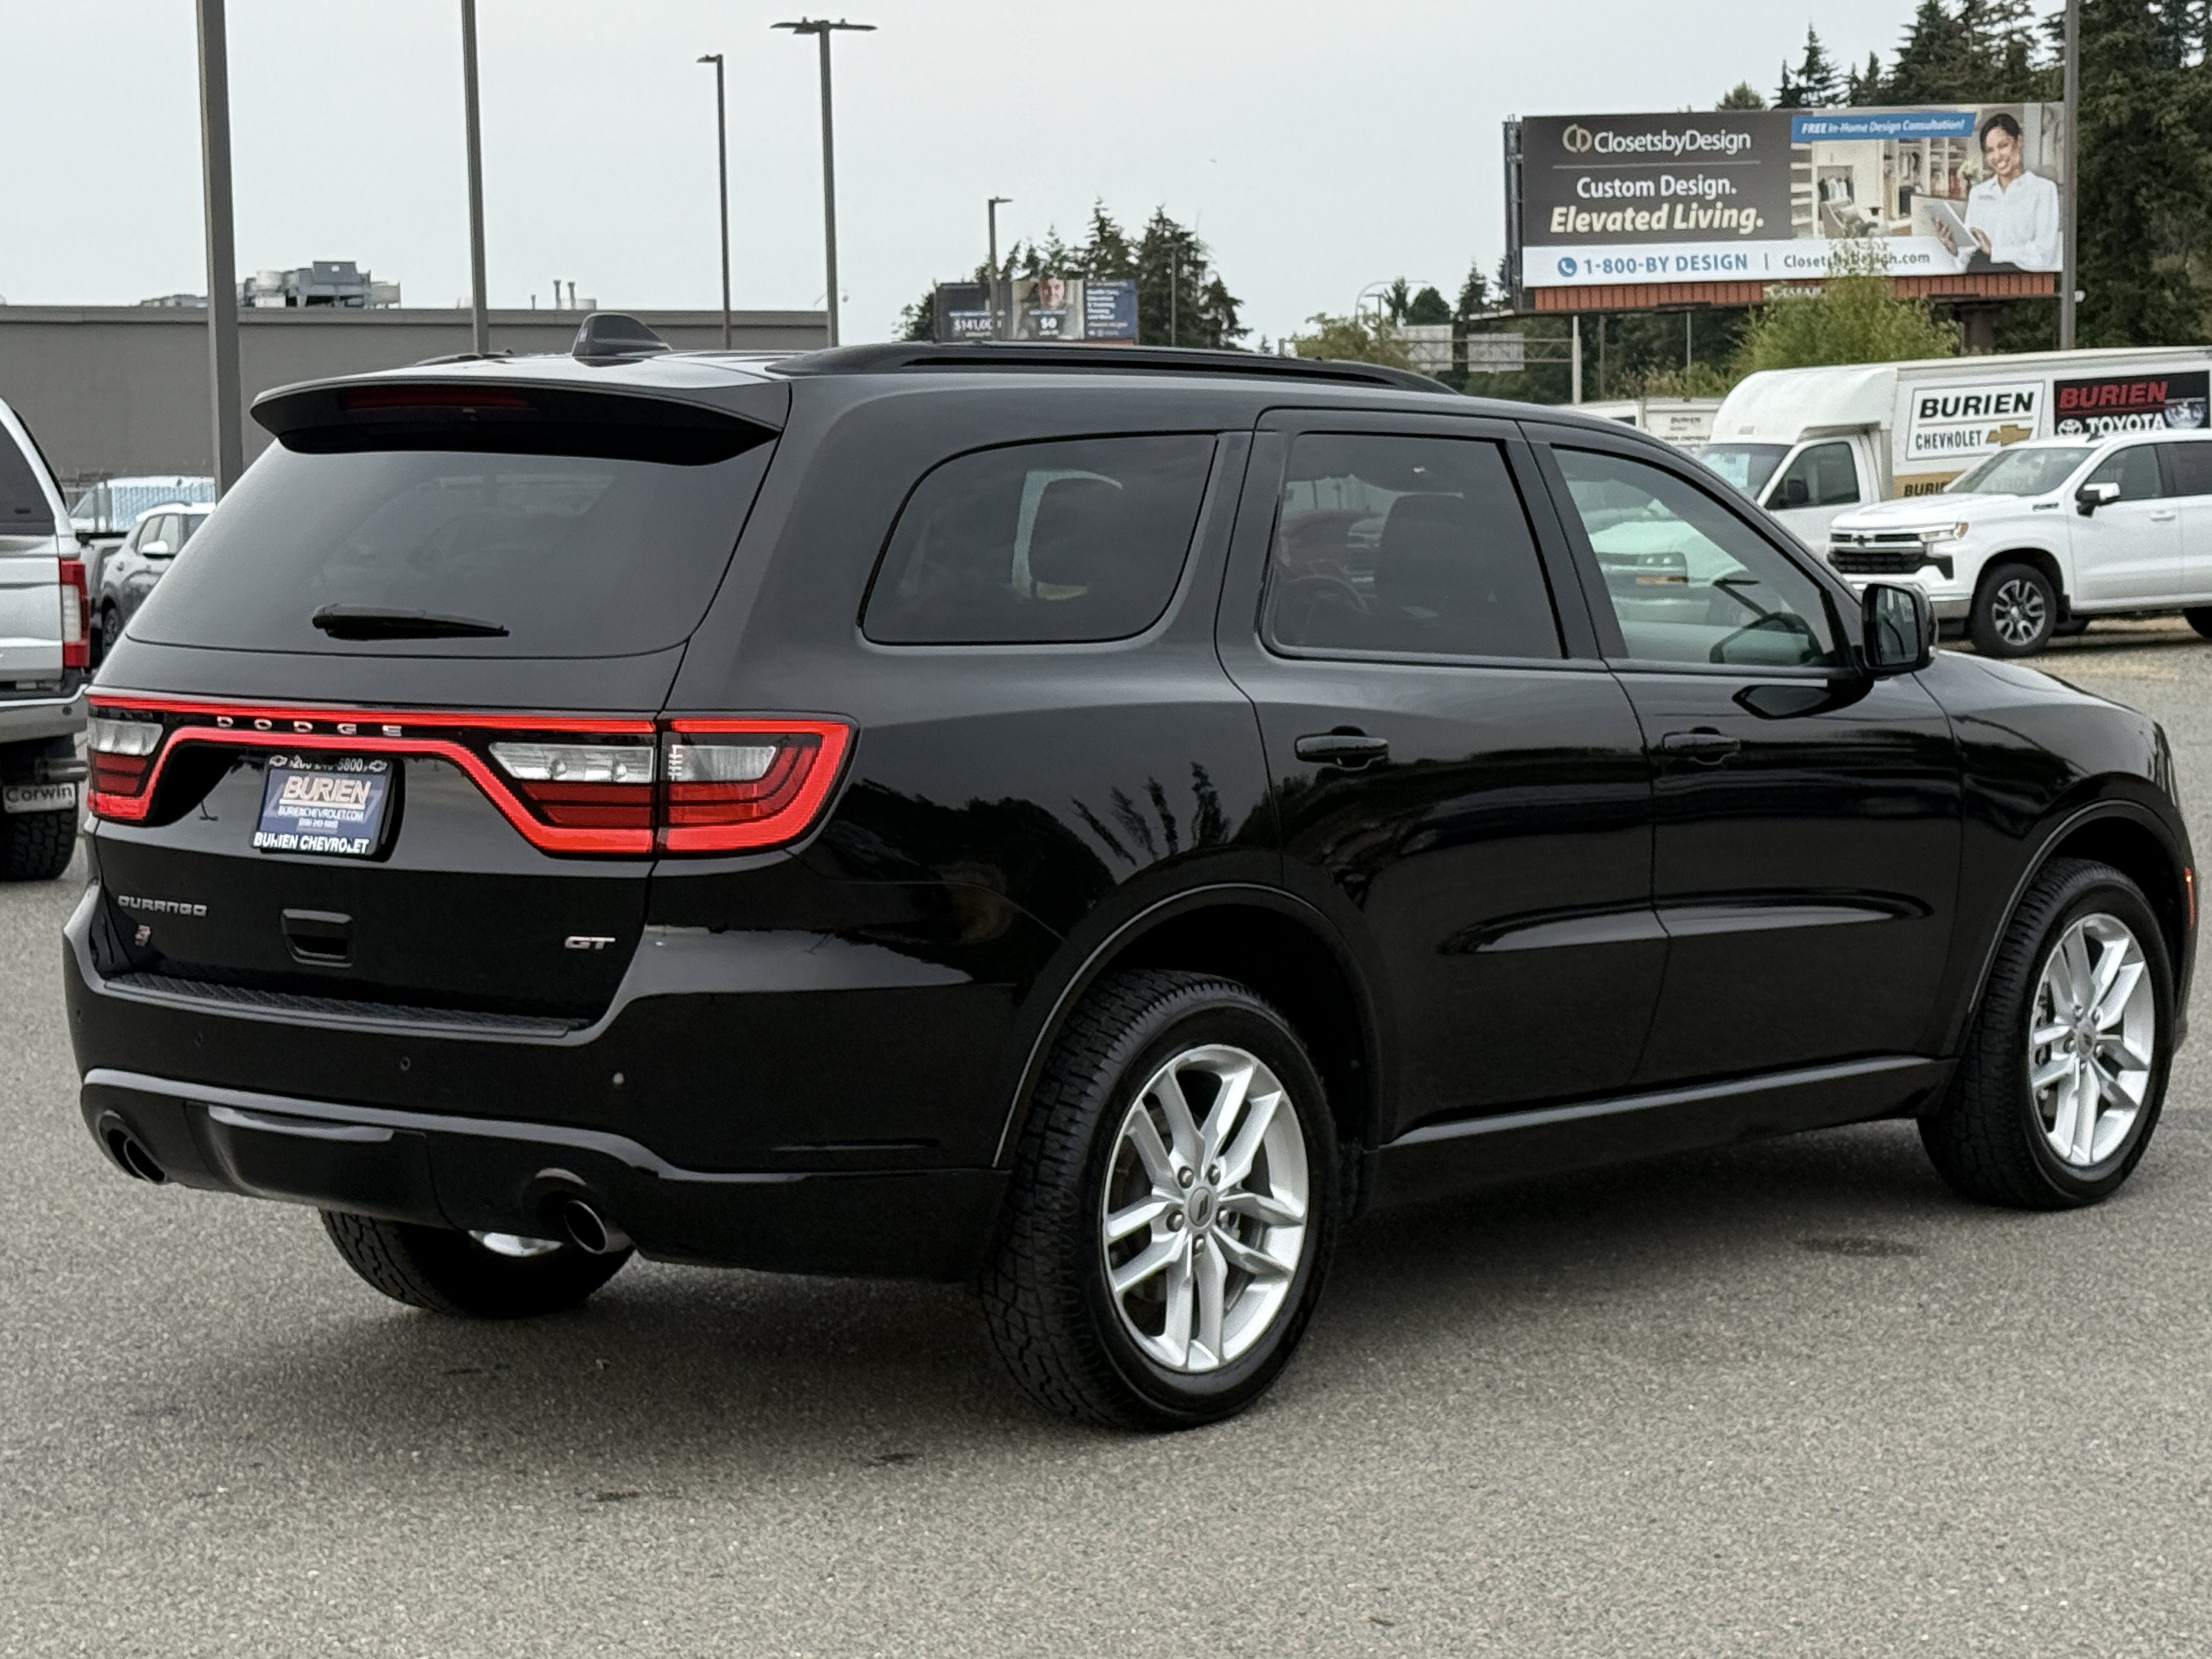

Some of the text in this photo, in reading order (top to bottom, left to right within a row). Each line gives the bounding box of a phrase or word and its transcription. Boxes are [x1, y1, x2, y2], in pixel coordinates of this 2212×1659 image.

[1801, 122, 1826, 134] FREE
[1869, 120, 1901, 134] Design
[1903, 119, 1966, 131] Consultation!
[1594, 129, 1751, 156] ClosetsbyDesign
[1577, 174, 1736, 200] Custom Design.
[1550, 202, 1764, 235] Elevated Living.
[1584, 253, 1930, 274] 1-800-BY DESIGN ClosetDen.com
[1920, 391, 2035, 419] BURIEN
[2059, 381, 2168, 409] BURIEN
[2085, 412, 2167, 436] TOYOTA
[1915, 430, 1982, 450] CHEVROLET
[1904, 481, 1948, 497] BURI
[217, 716, 402, 737] DODGE
[5, 785, 72, 803] Corwin
[283, 775, 372, 804] BURIEN
[117, 895, 207, 917] DURANGO
[565, 936, 616, 950] GT
